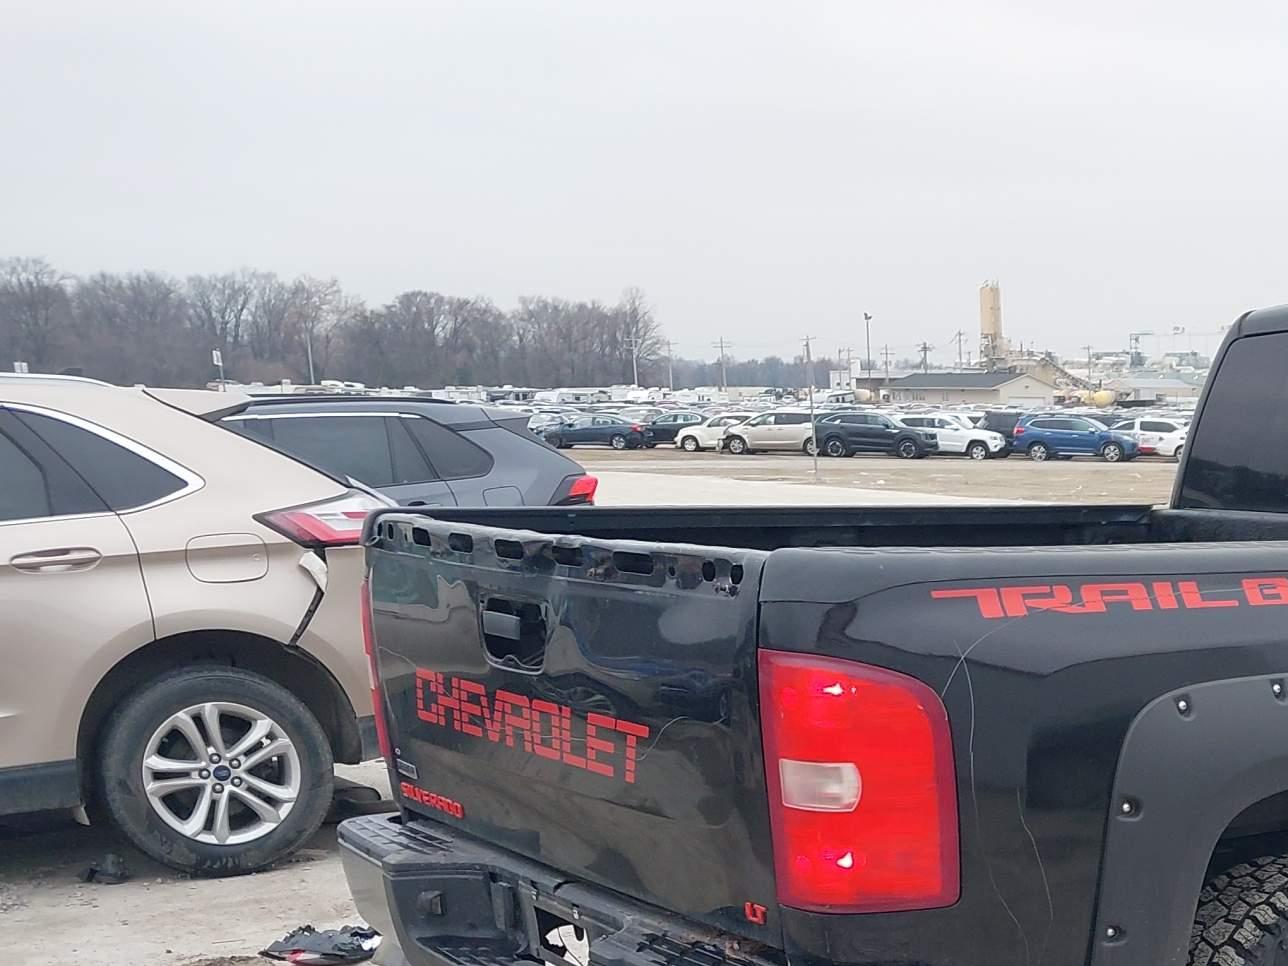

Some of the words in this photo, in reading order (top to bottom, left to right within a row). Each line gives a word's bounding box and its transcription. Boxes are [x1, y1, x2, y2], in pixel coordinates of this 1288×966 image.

[931, 580, 1238, 619] TRAIL
[415, 667, 650, 784] CHEVROLET
[400, 782, 464, 818] SILVERADO
[744, 902, 766, 924] LT
